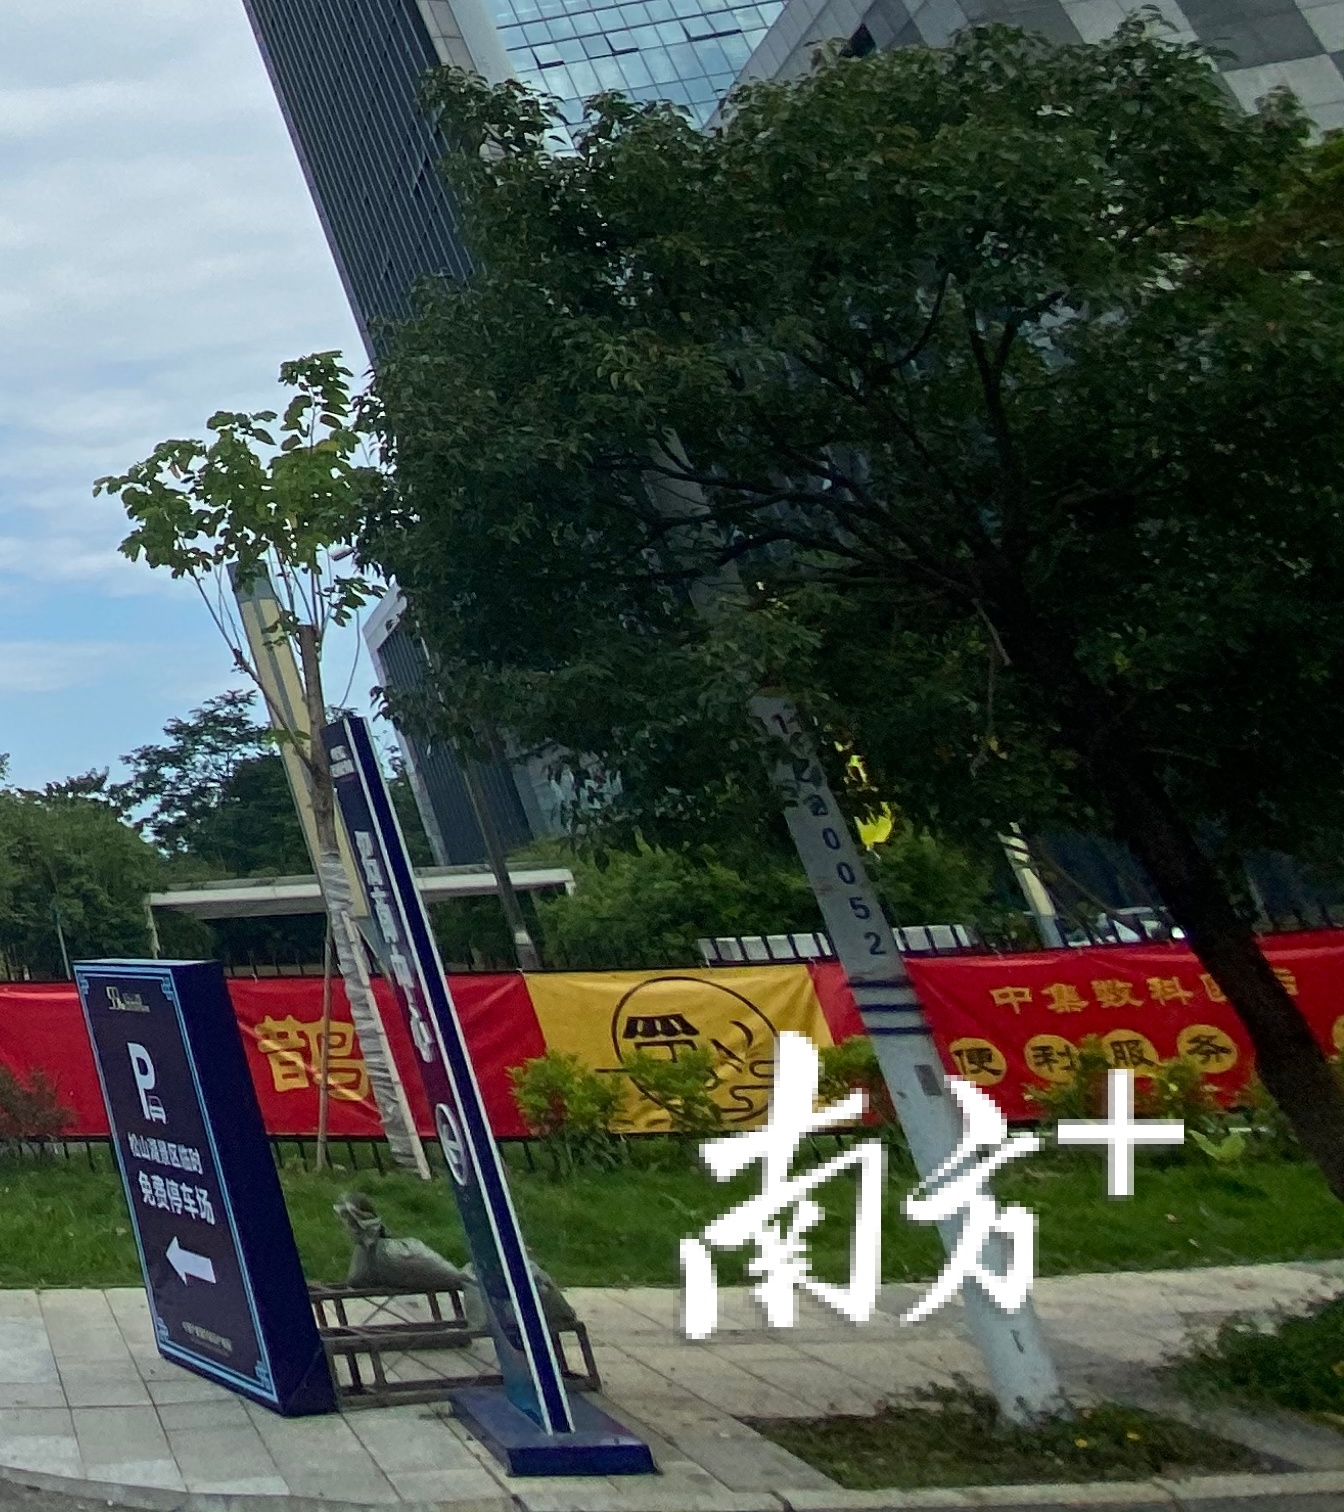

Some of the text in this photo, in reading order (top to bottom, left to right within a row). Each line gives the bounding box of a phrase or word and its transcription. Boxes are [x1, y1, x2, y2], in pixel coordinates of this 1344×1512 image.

[126, 1040, 158, 1121] P
[127, 1130, 204, 1176] 松山湖景区临时
[137, 1168, 216, 1227] 免费停车场
